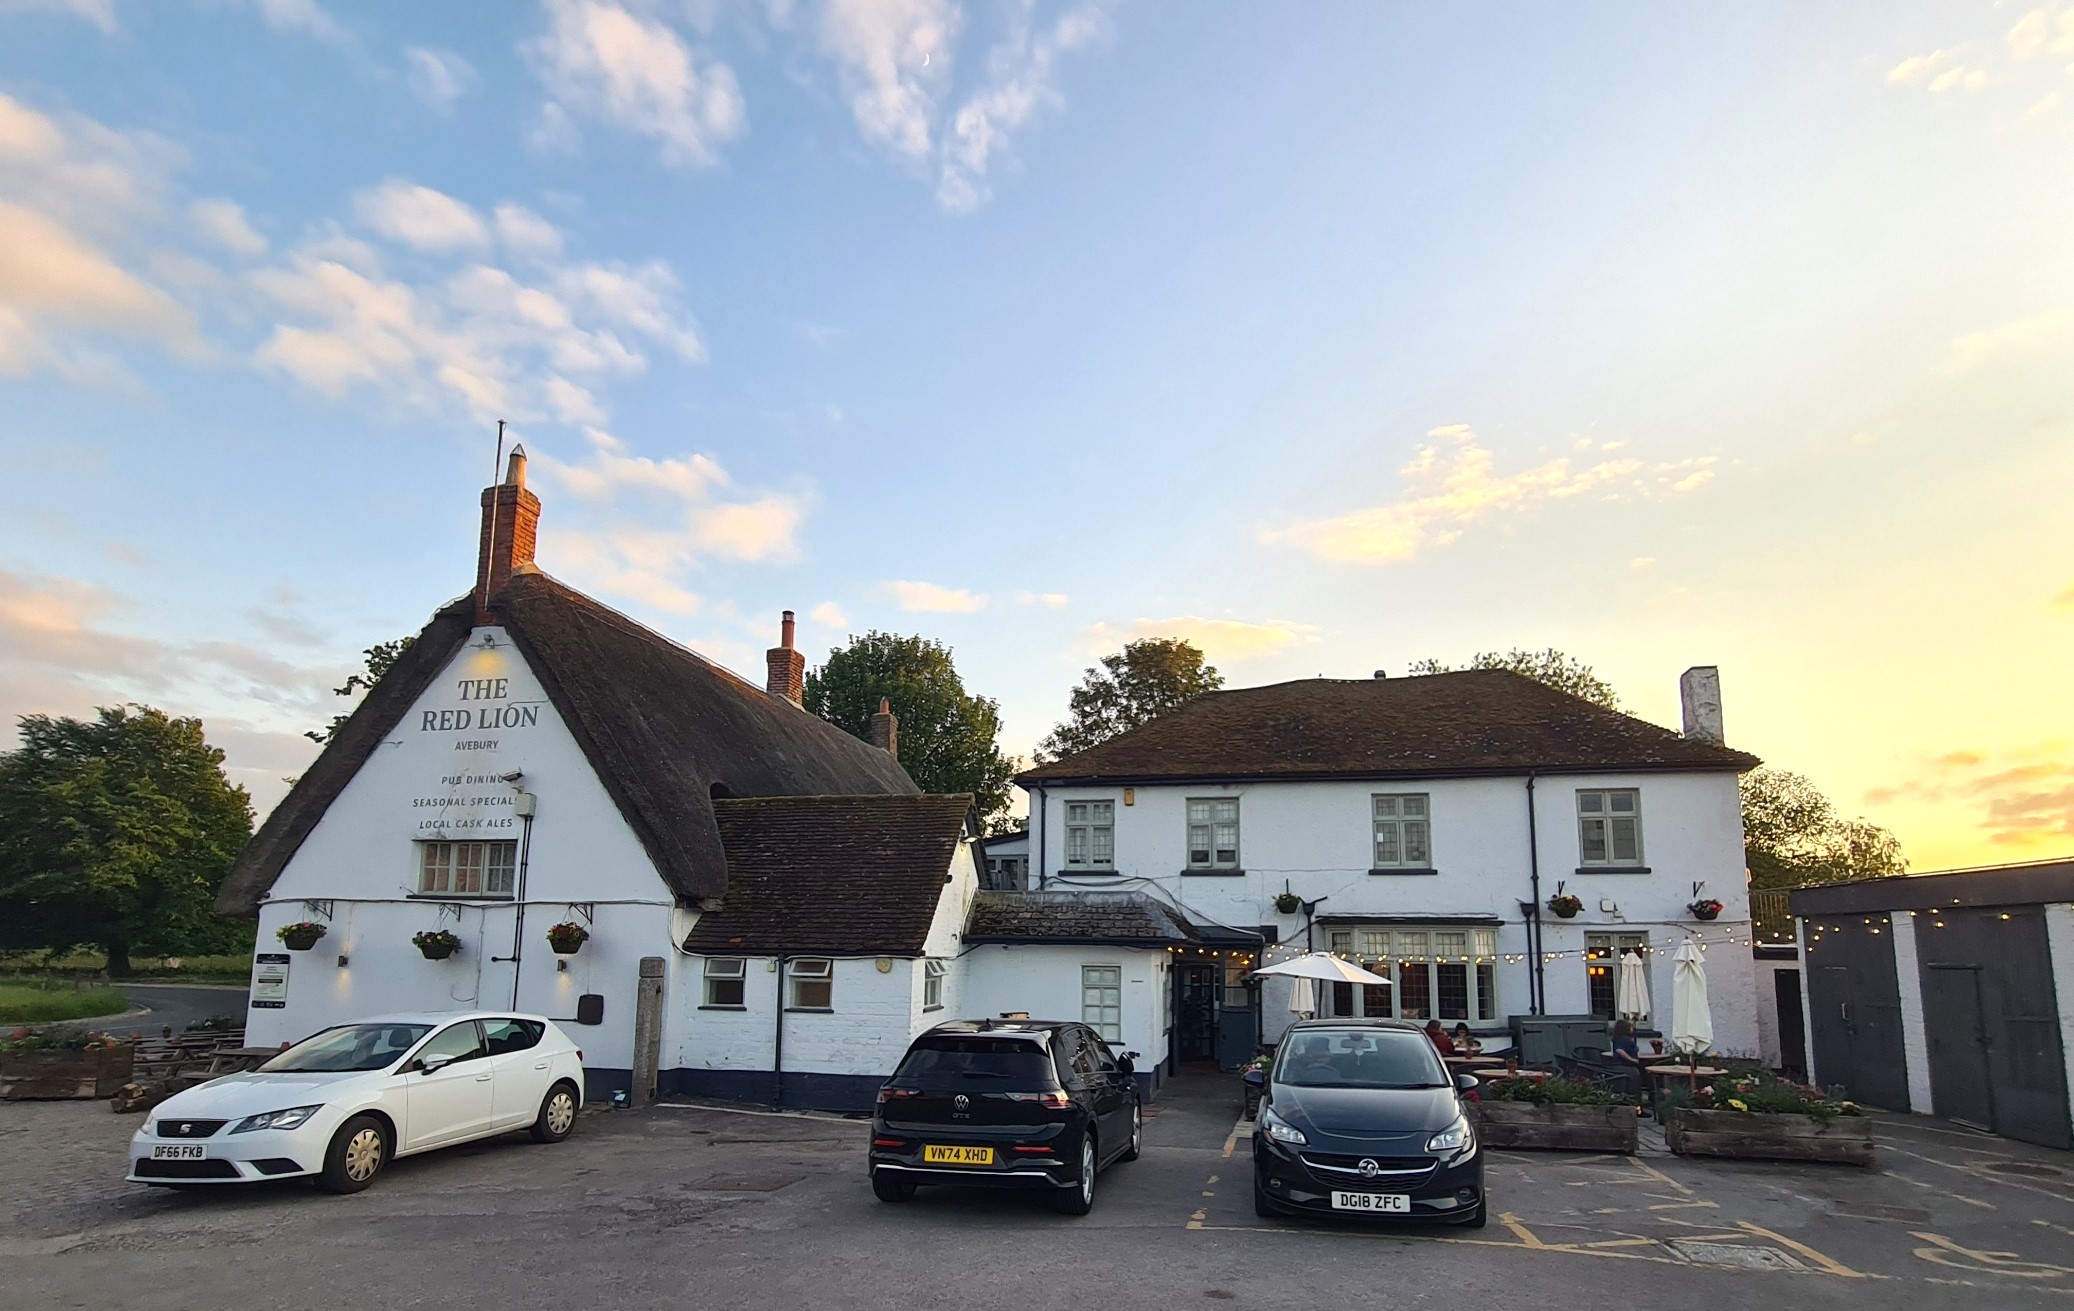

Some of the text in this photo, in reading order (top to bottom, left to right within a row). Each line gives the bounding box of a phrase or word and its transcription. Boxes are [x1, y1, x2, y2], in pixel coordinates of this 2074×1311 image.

[458, 678, 508, 701] THE
[420, 705, 540, 731] RED LION
[454, 740, 499, 751] AVEBURY
[441, 776, 462, 785] PUB
[413, 797, 466, 807] SEASONAL
[419, 818, 513, 829] LOCAL CASK ALES
[154, 1146, 203, 1158] DF66 FKB
[931, 1147, 988, 1162] VN74 XHD
[1340, 1194, 1401, 1209] DG18 ZFC
